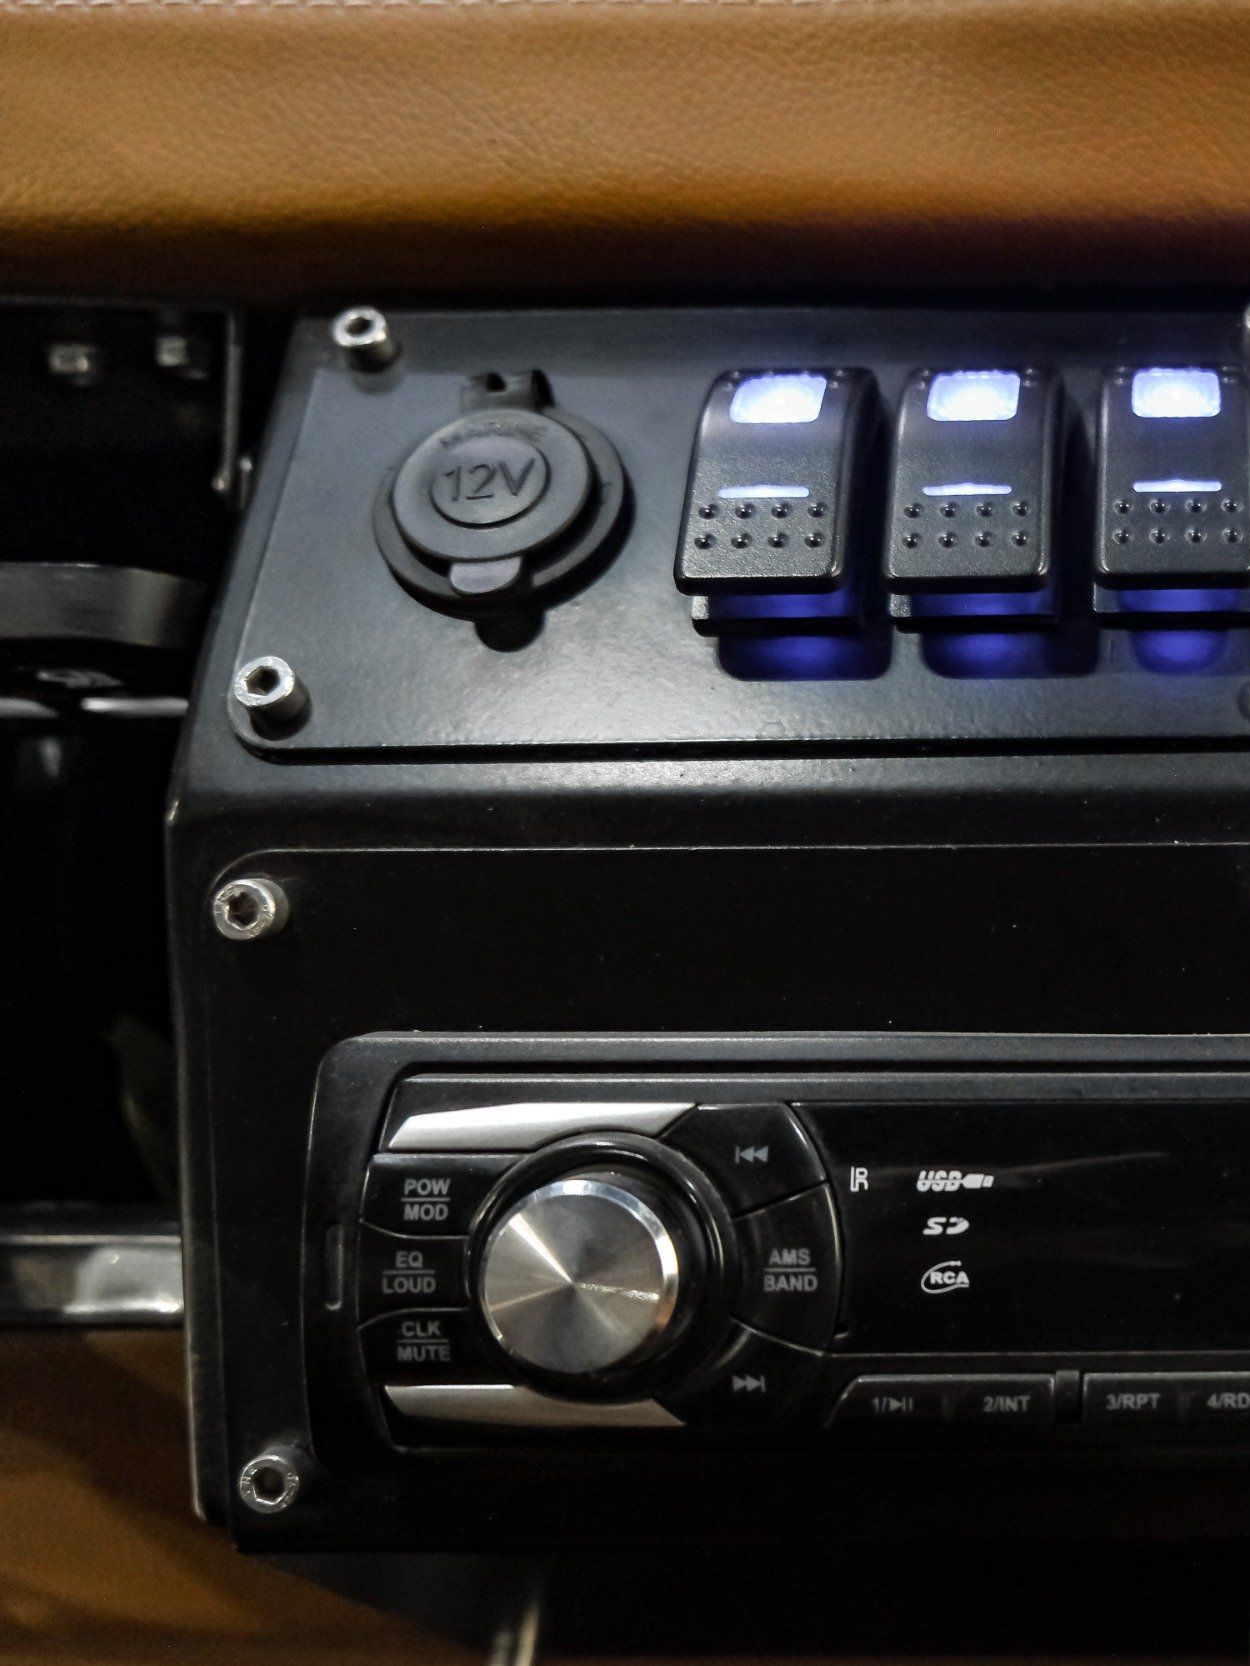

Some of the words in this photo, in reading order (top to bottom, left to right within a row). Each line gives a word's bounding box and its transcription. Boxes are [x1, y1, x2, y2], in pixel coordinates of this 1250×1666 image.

[444, 457, 536, 502] 12V
[404, 1178, 451, 1196] POW
[403, 1203, 449, 1221] MOD
[395, 1250, 424, 1269] EQ
[769, 1248, 811, 1266] AMS
[382, 1274, 437, 1294] LOUD
[764, 1274, 818, 1292] BAND
[929, 1270, 971, 1286] RCA
[401, 1320, 442, 1338] CLK
[397, 1344, 450, 1362] MUTE
[984, 1395, 1031, 1413] 2/INT
[1106, 1392, 1161, 1410] 3/RPT
